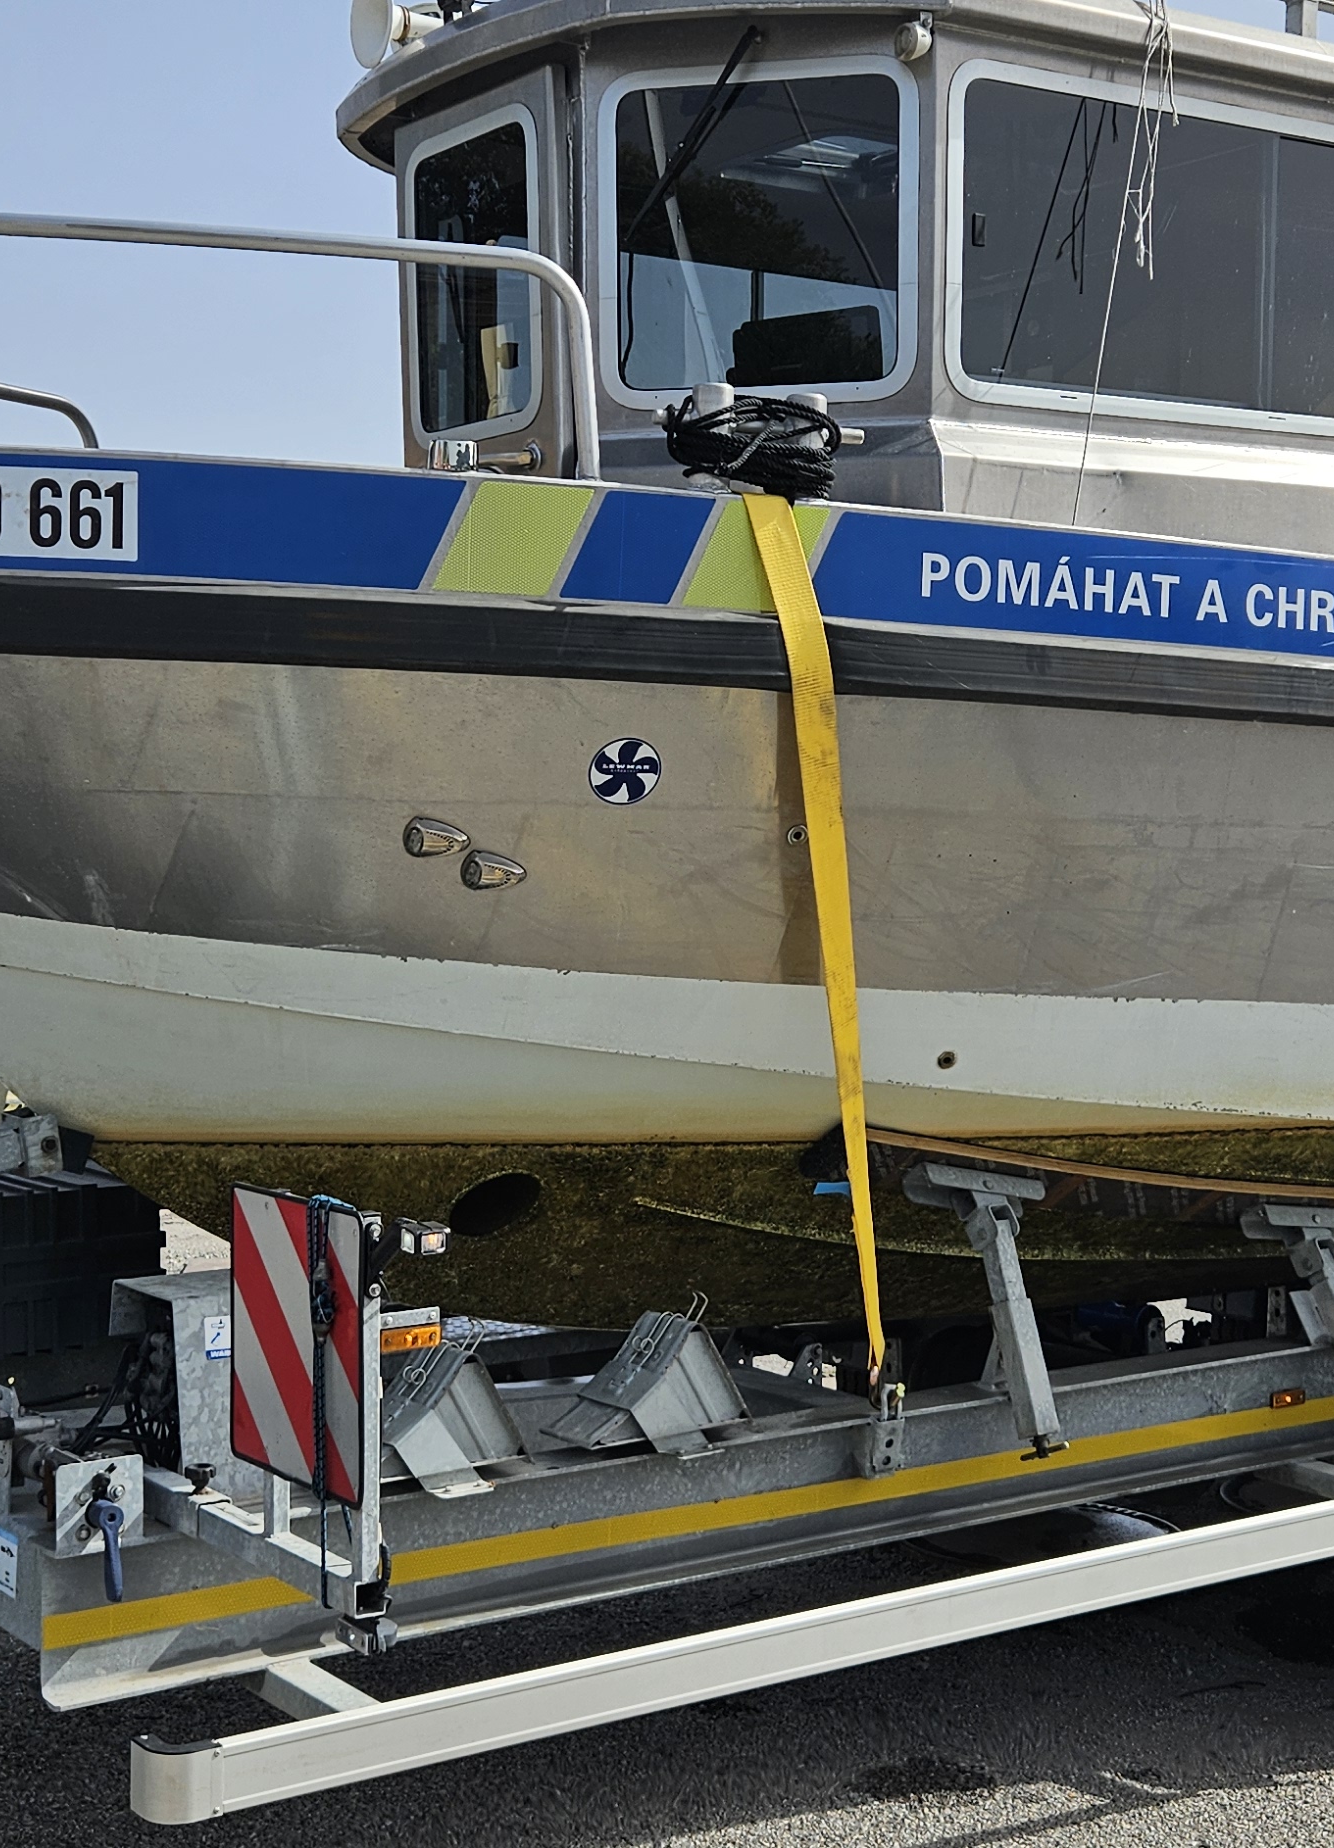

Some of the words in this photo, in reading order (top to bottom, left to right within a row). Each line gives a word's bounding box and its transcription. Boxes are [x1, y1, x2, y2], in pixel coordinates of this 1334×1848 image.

[29, 477, 124, 550] 661
[921, 552, 1181, 619] POMÁHAT
[1196, 579, 1228, 624] A
